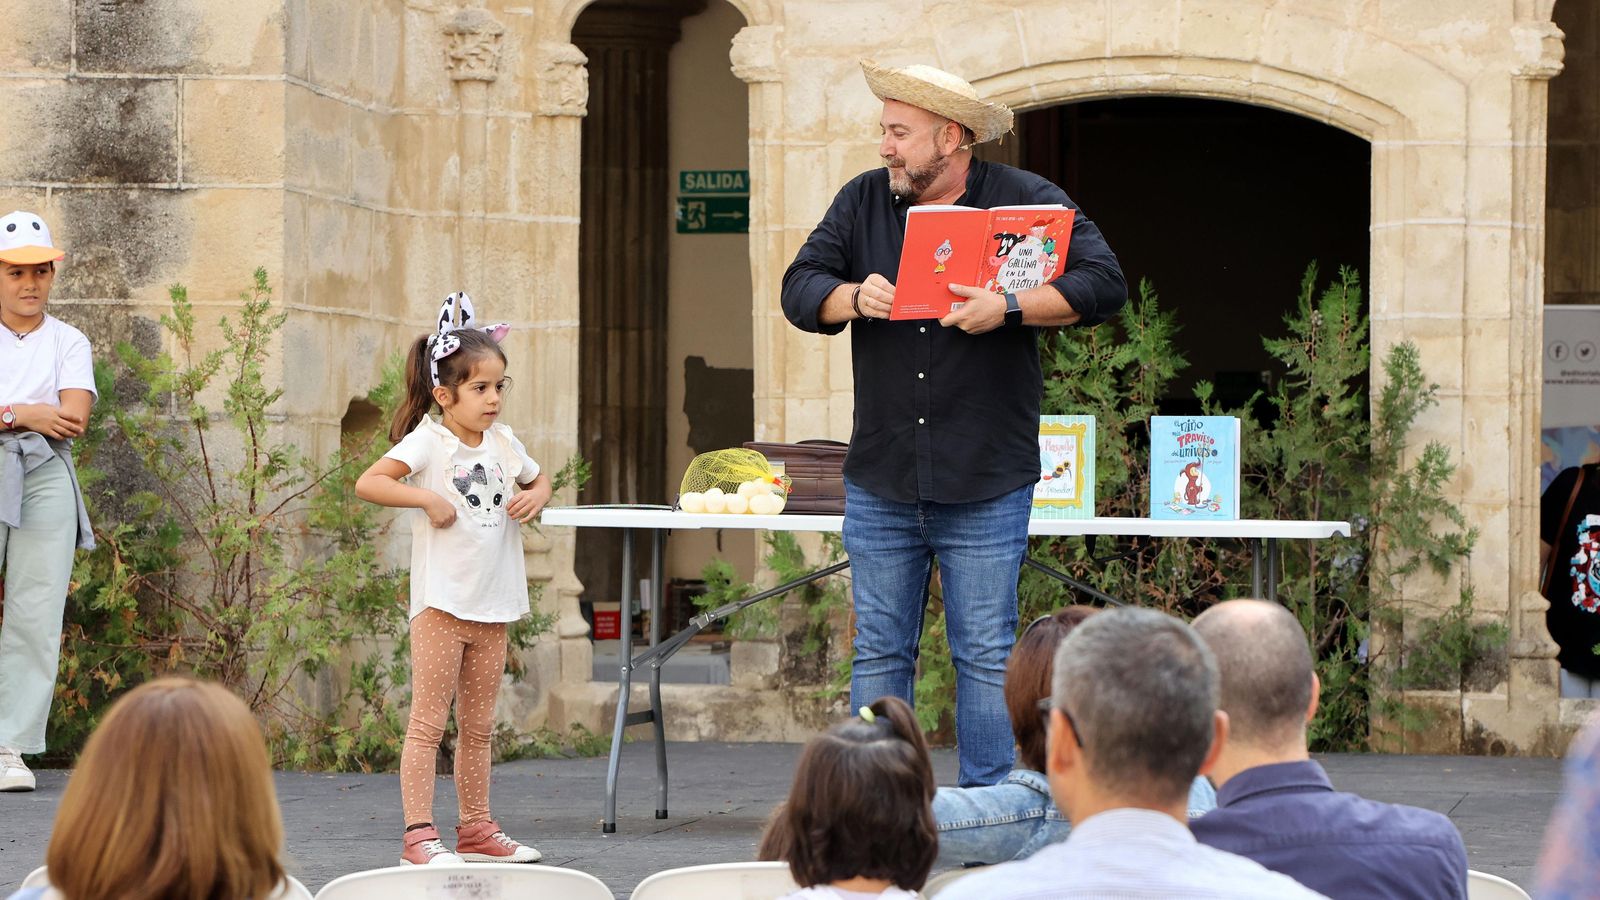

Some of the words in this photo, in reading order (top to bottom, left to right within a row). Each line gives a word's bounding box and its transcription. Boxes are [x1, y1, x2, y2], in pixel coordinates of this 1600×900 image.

[685, 173, 744, 189] SALIDA
[1008, 278, 1038, 289] AZOTEA
[1180, 419, 1204, 432] niño
[1177, 431, 1215, 449] TRAVIESO
[1179, 445, 1218, 458] universo
